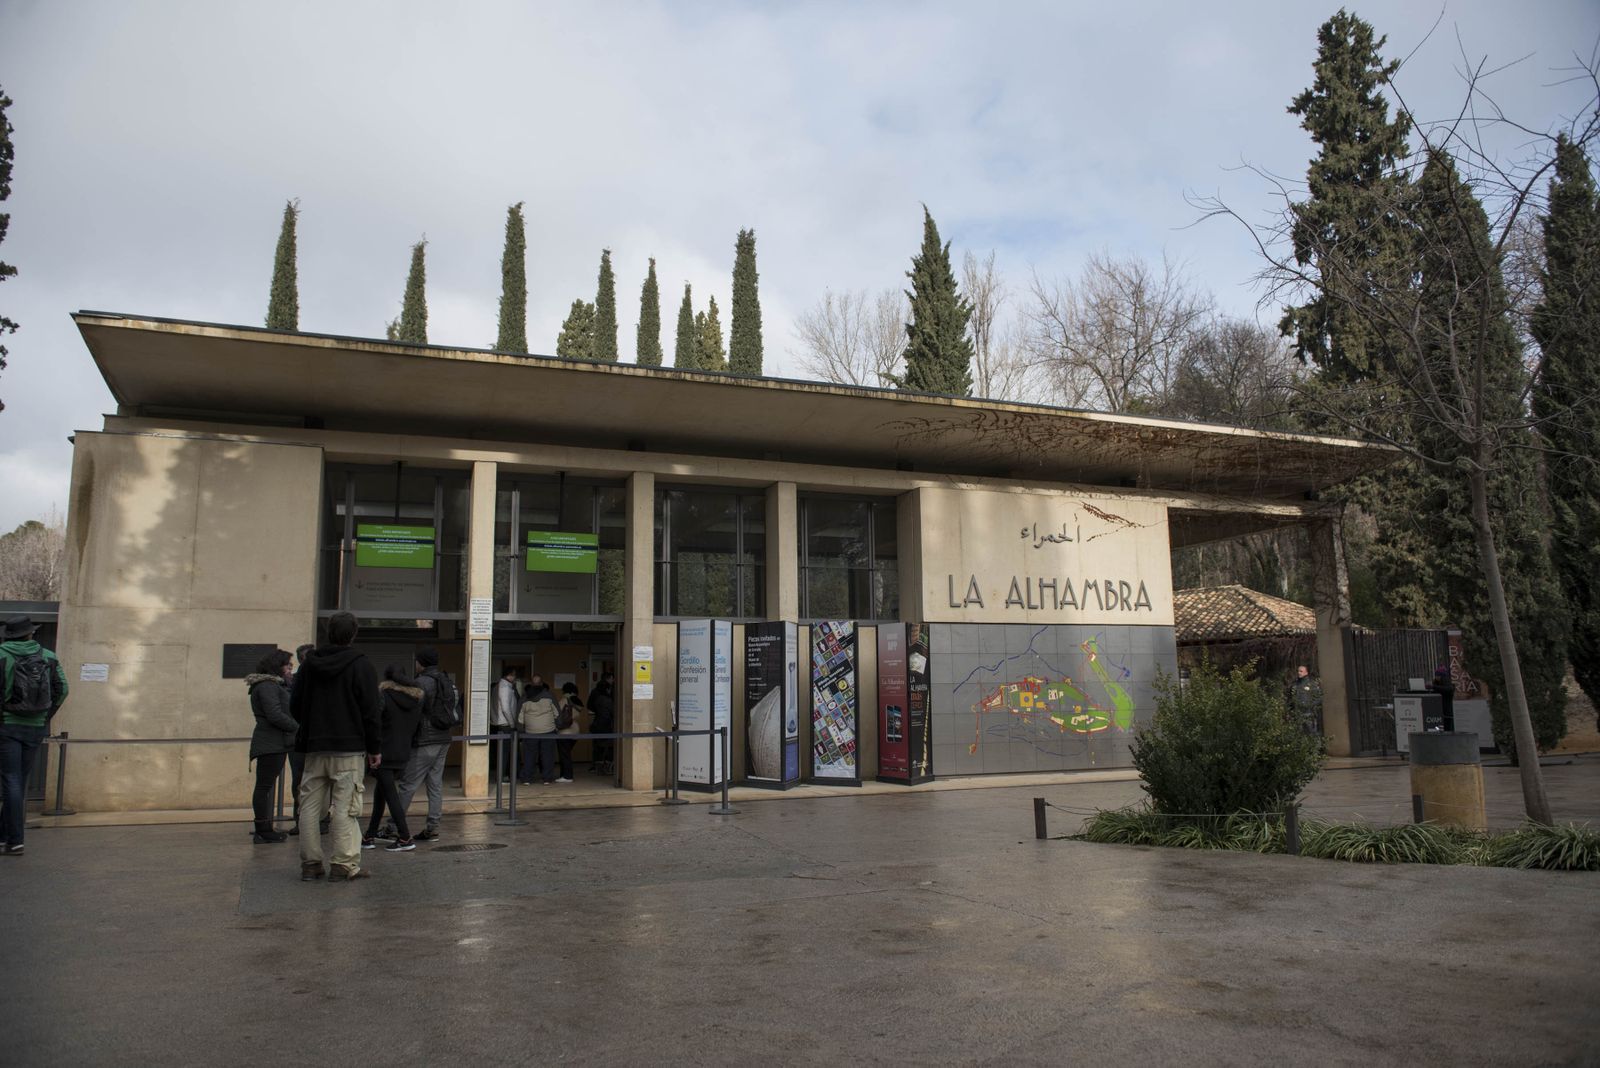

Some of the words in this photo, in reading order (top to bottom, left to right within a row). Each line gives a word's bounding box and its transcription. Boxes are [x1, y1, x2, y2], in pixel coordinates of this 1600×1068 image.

[1020, 522, 1080, 549] الحمراء
[948, 574, 984, 609] LA
[1006, 575, 1152, 611] ALHAMBRA
